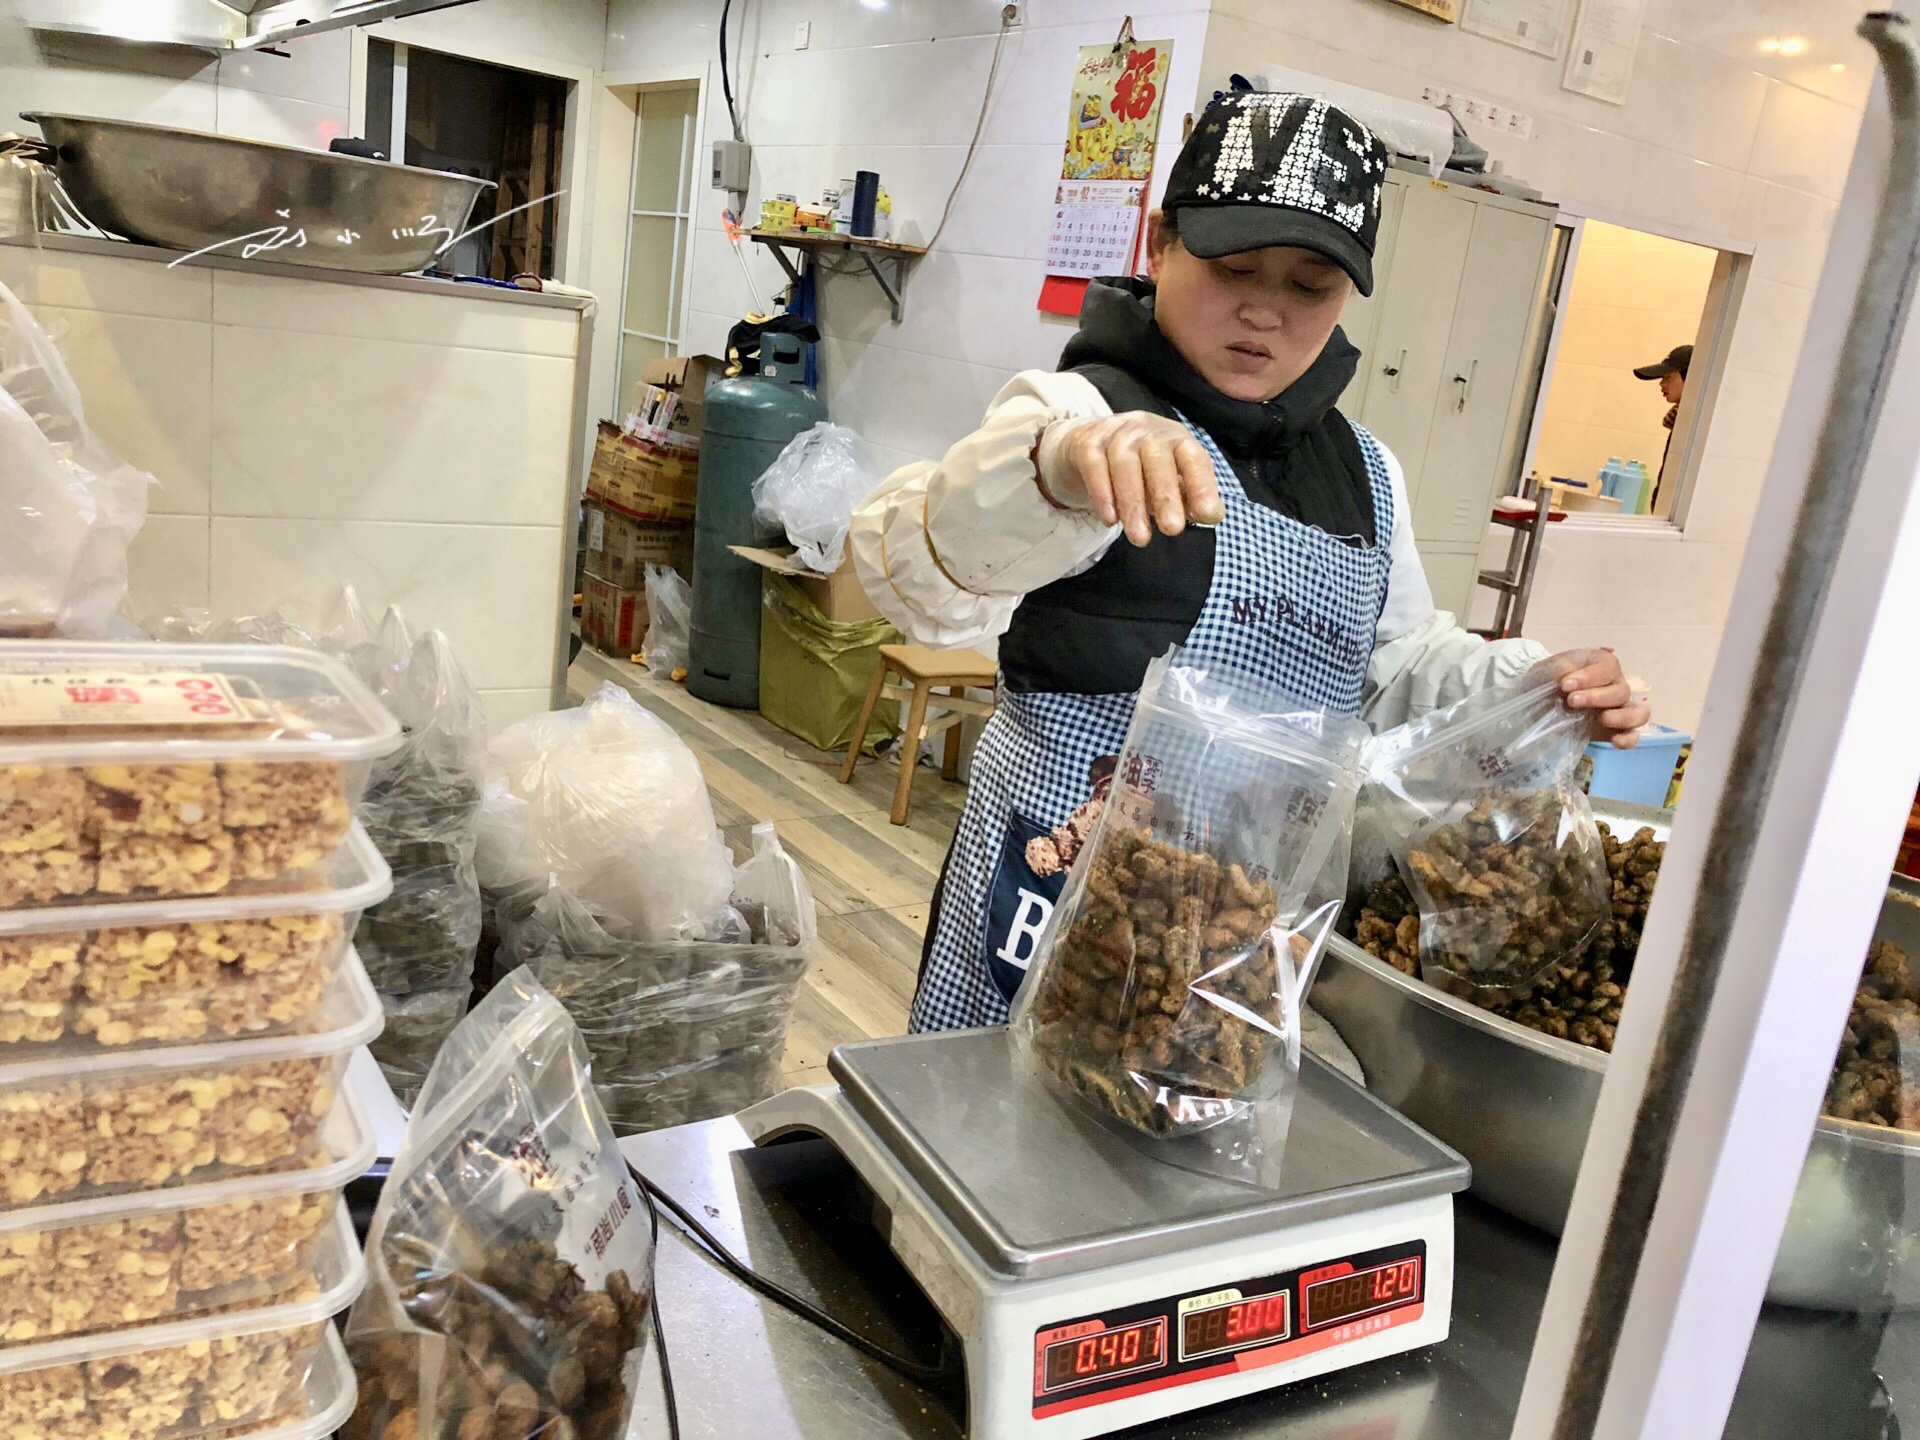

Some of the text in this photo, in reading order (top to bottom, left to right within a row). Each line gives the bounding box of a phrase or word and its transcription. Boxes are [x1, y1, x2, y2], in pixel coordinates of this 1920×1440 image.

[1110, 48, 1156, 123] 福
[1231, 595, 1268, 625] MY
[1373, 1262, 1415, 1299] 1.20
[1226, 1295, 1284, 1339] 3.00
[1075, 1324, 1162, 1375] 0.401
